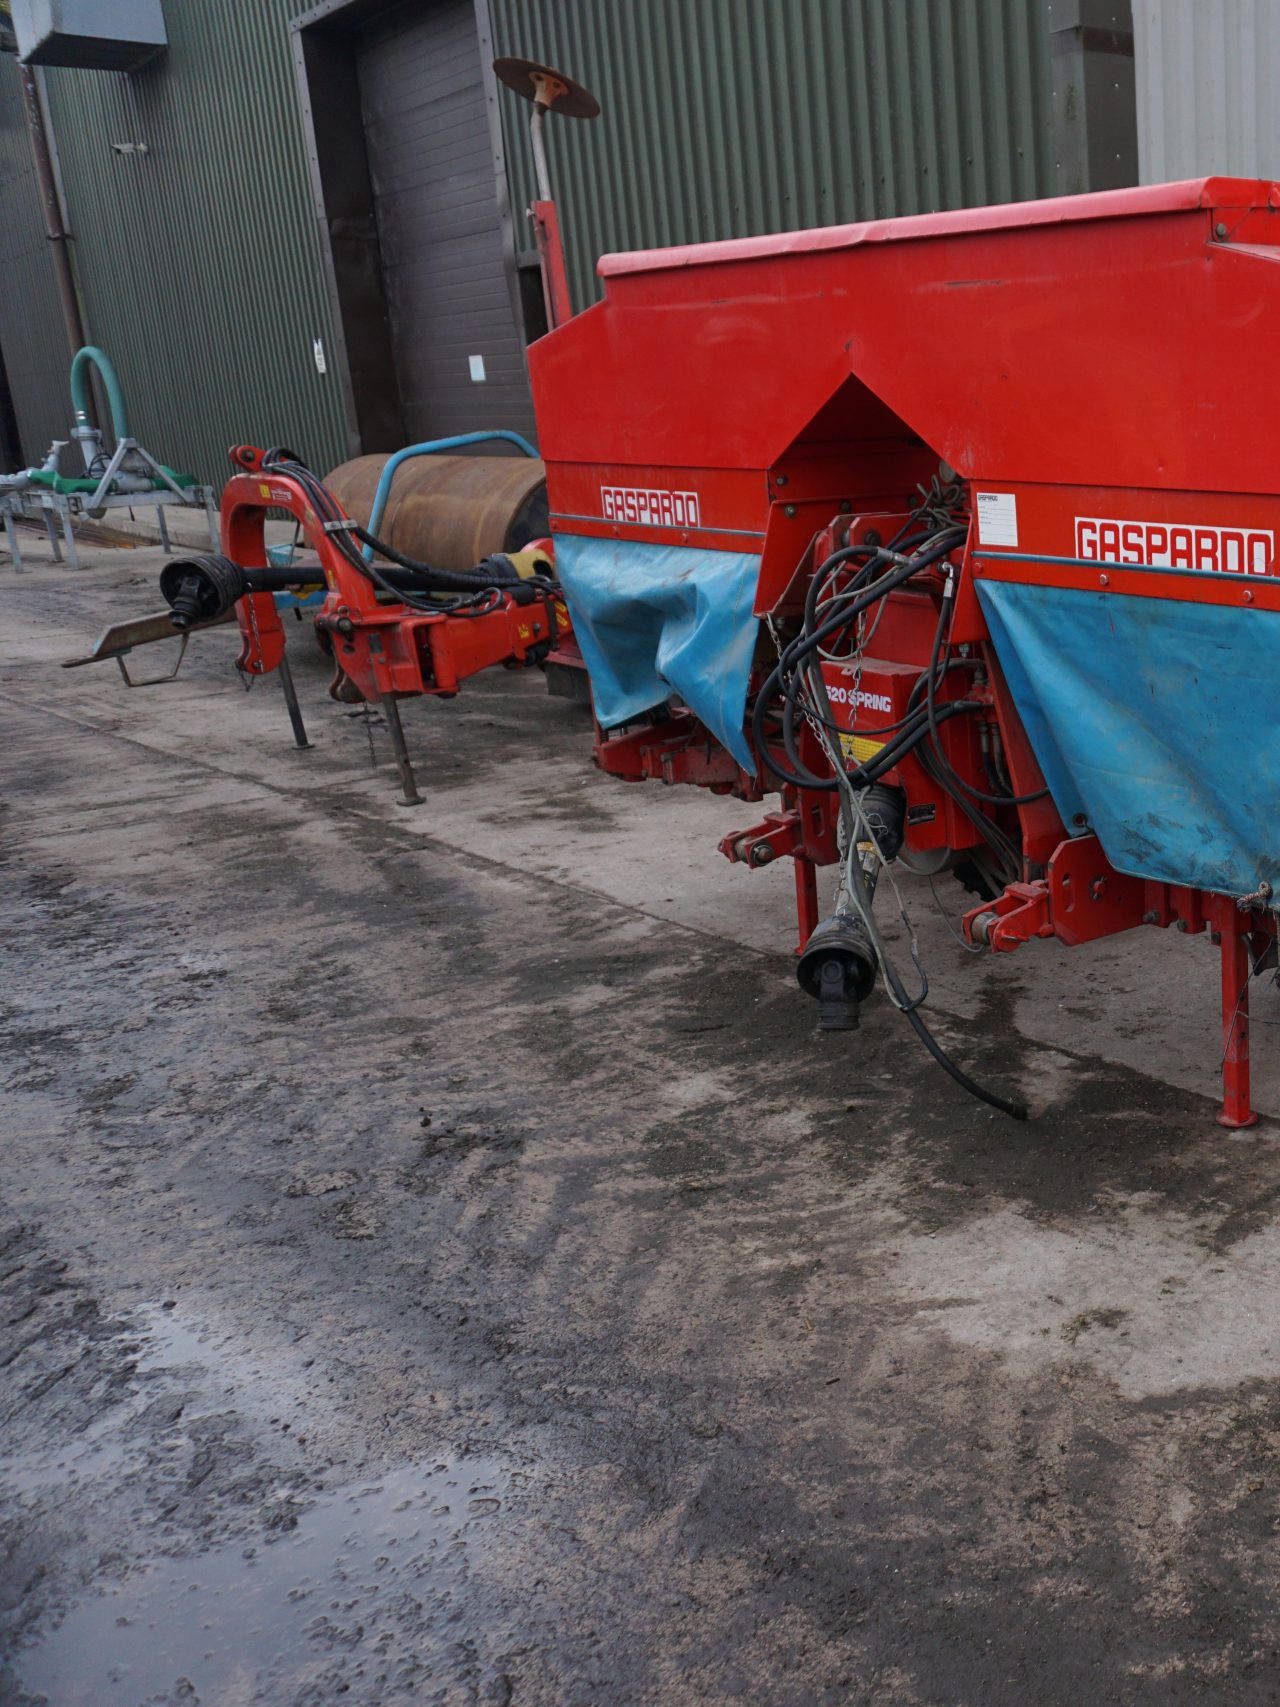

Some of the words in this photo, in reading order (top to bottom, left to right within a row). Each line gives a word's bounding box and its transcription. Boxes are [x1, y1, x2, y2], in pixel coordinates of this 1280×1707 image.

[602, 487, 700, 528] GASPARDO
[1076, 519, 1273, 576] GASPARDO
[847, 689, 892, 713] SPRING
